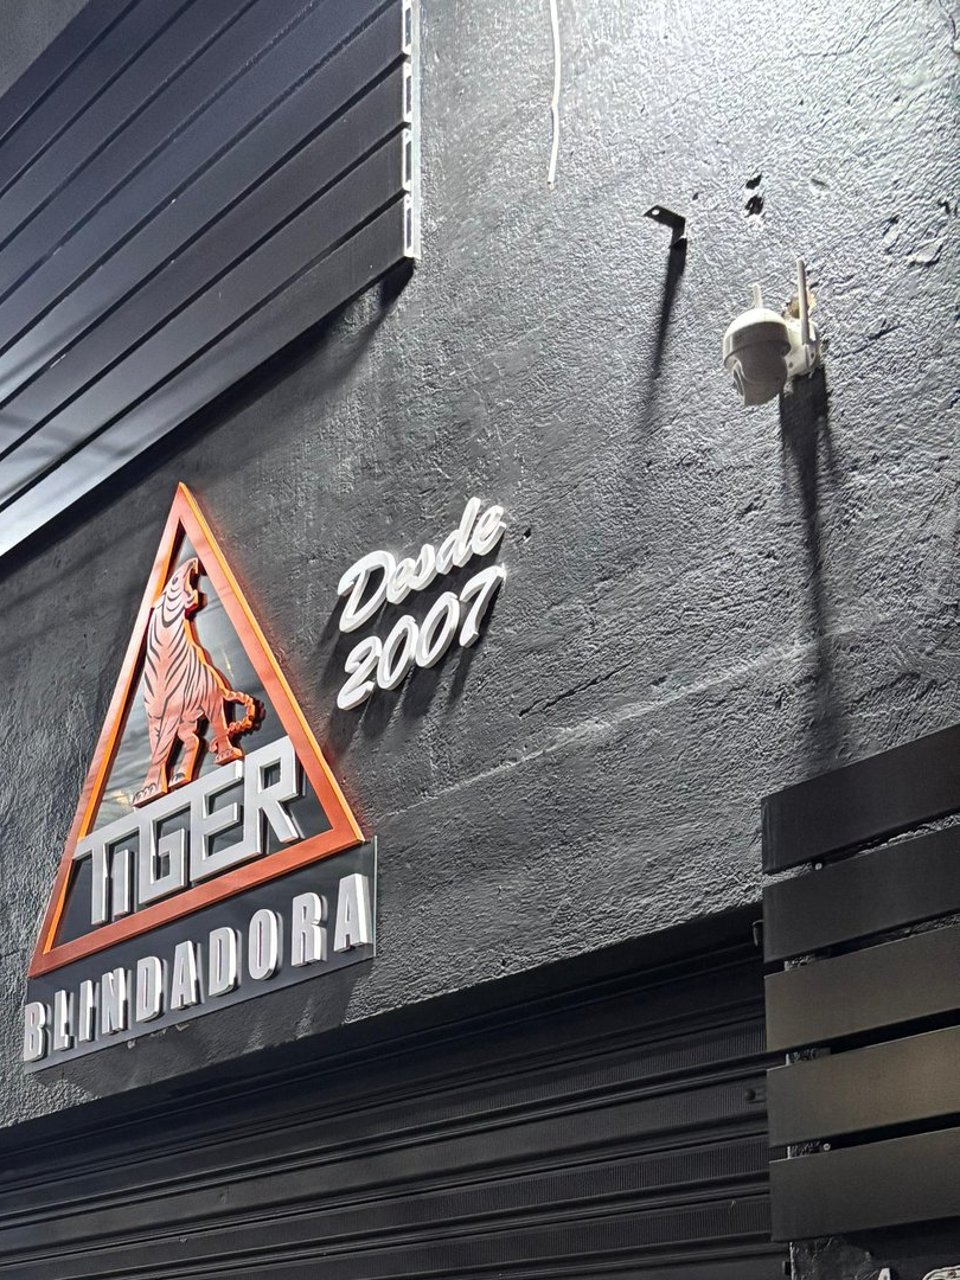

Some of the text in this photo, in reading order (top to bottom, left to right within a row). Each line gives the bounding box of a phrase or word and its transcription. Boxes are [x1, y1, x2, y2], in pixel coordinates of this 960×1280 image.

[337, 563, 507, 710] 2007
[339, 496, 507, 633] Desde
[23, 872, 374, 1062] BLINDADORA
